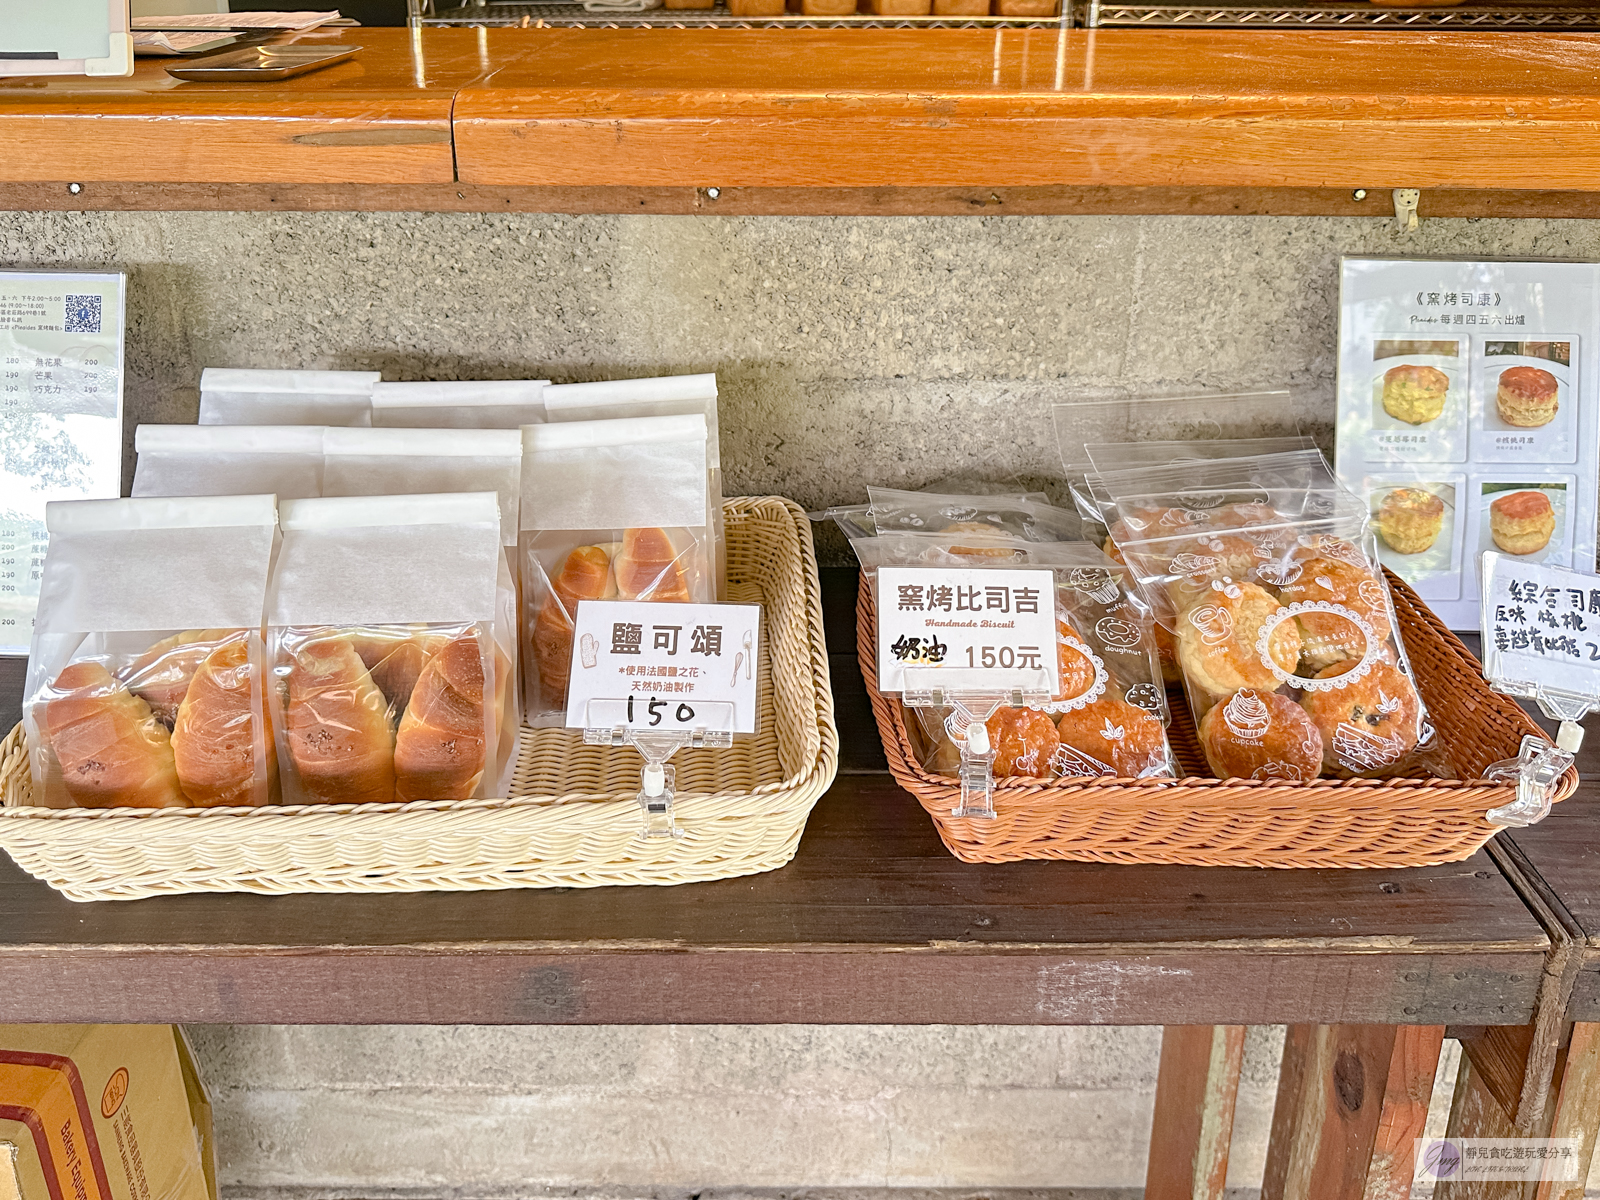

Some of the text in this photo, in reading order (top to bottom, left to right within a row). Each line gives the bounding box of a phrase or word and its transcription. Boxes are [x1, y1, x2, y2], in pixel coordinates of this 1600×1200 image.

[1416, 292, 1502, 306] 《窯烤司康》
[1440, 314, 1525, 326] 每週四五六出爐
[35, 357, 63, 367] 無花果
[34, 371, 53, 380] 芒果
[34, 385, 62, 394] 巧克力
[4, 398, 18, 406] 190
[1, 571, 15, 579] 190
[1278, 585, 1305, 593] hotdog
[897, 584, 1040, 614] 窯烤比司吉
[1105, 602, 1129, 614] muffin
[1, 618, 15, 626] 200
[924, 618, 1016, 629] Handmade Biscuit
[609, 622, 723, 657] 鹽可頌
[890, 633, 948, 663] 奶油
[965, 646, 1043, 671] 150元
[1105, 645, 1142, 656] doughnut
[1207, 646, 1229, 658] coffee
[631, 681, 695, 693] 天然奶油製作
[627, 695, 695, 726] 150
[1230, 737, 1264, 747] cupcake
[60, 1117, 77, 1168] Bakery
